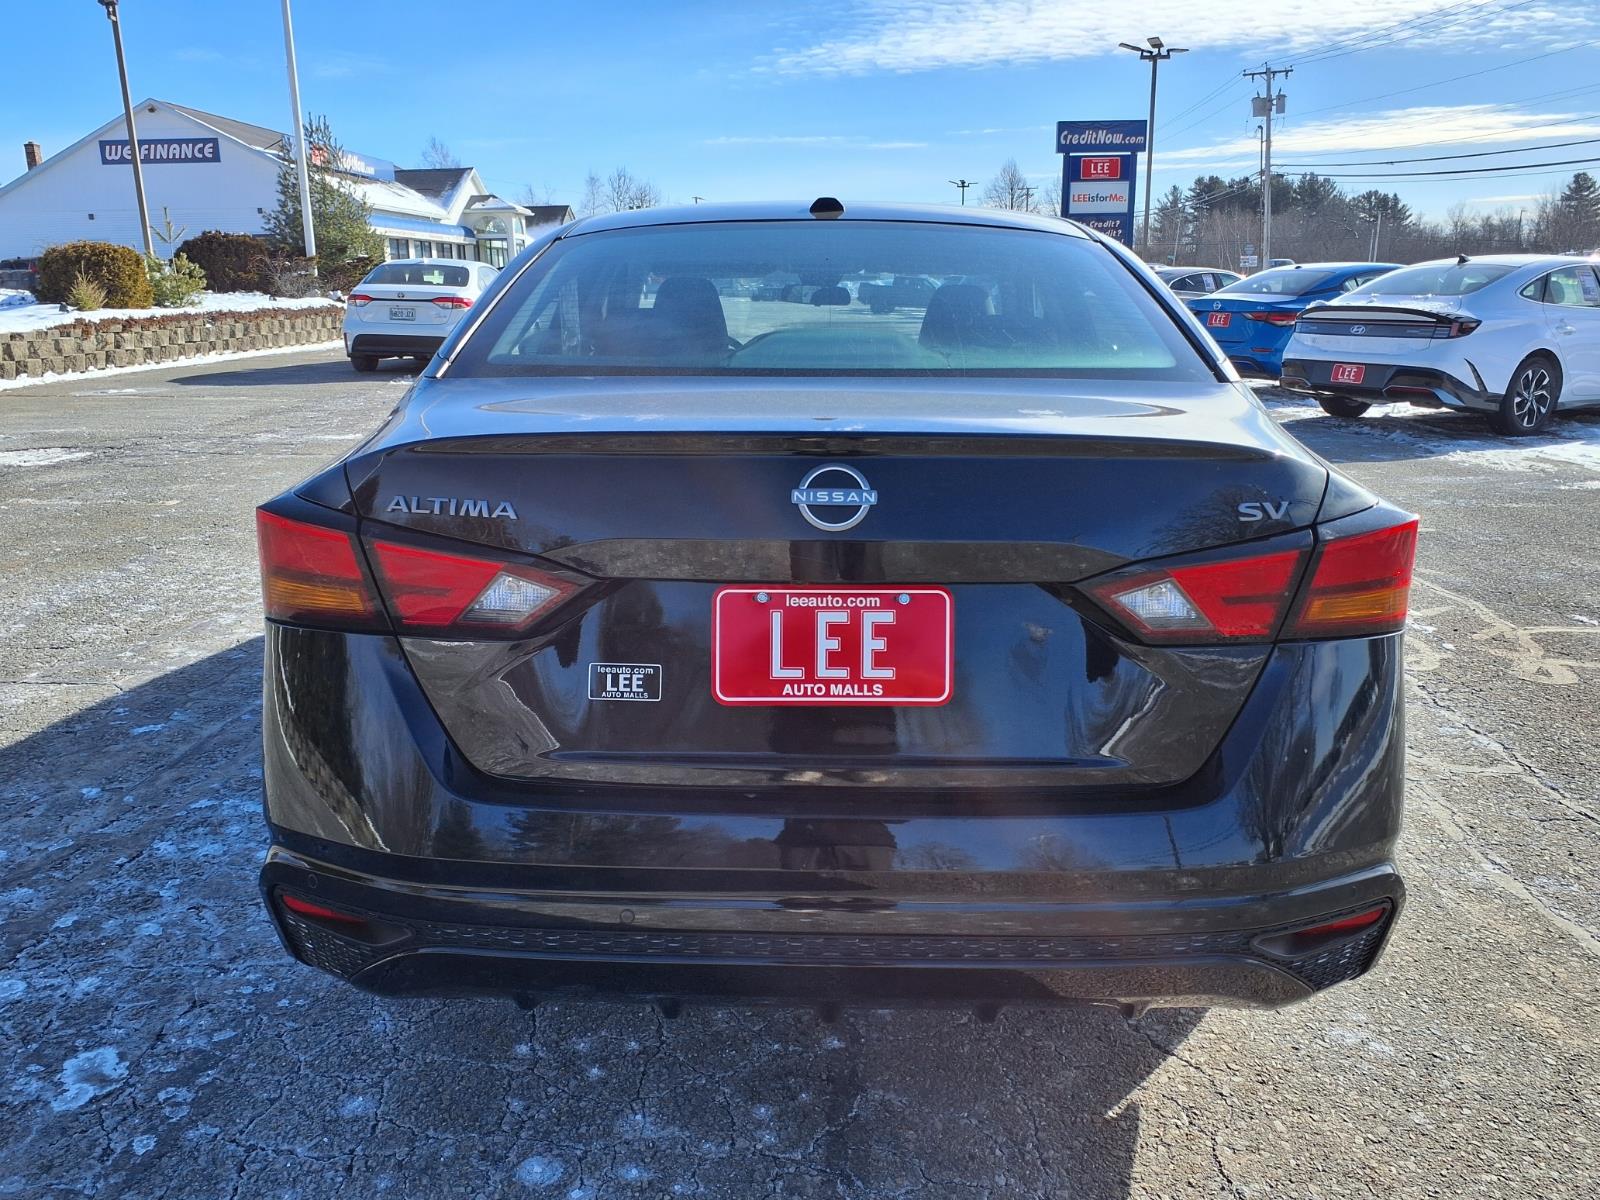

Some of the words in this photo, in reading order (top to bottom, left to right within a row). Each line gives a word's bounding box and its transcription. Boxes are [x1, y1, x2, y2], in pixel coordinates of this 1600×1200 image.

[1060, 129, 1145, 146] CreditNow.com
[105, 145, 132, 161] WE
[140, 142, 214, 160] FINANCE
[1090, 162, 1110, 174] LEE
[1071, 193, 1127, 203] LEEisforMe.
[1089, 220, 1121, 229] Credit?
[1212, 315, 1226, 324] LEE
[1337, 367, 1358, 380] LEE
[792, 489, 876, 504] NISSAN
[386, 494, 519, 521] ALTIMA
[1237, 501, 1290, 522] SV
[785, 594, 881, 608] leeauto.com
[769, 609, 896, 680] LEE
[597, 665, 654, 675] leeauto.com
[605, 673, 644, 692] LEE
[601, 691, 622, 699] AUTO
[623, 691, 649, 699] MALLS
[782, 684, 827, 696] AUTO
[829, 684, 884, 696] MALLS
